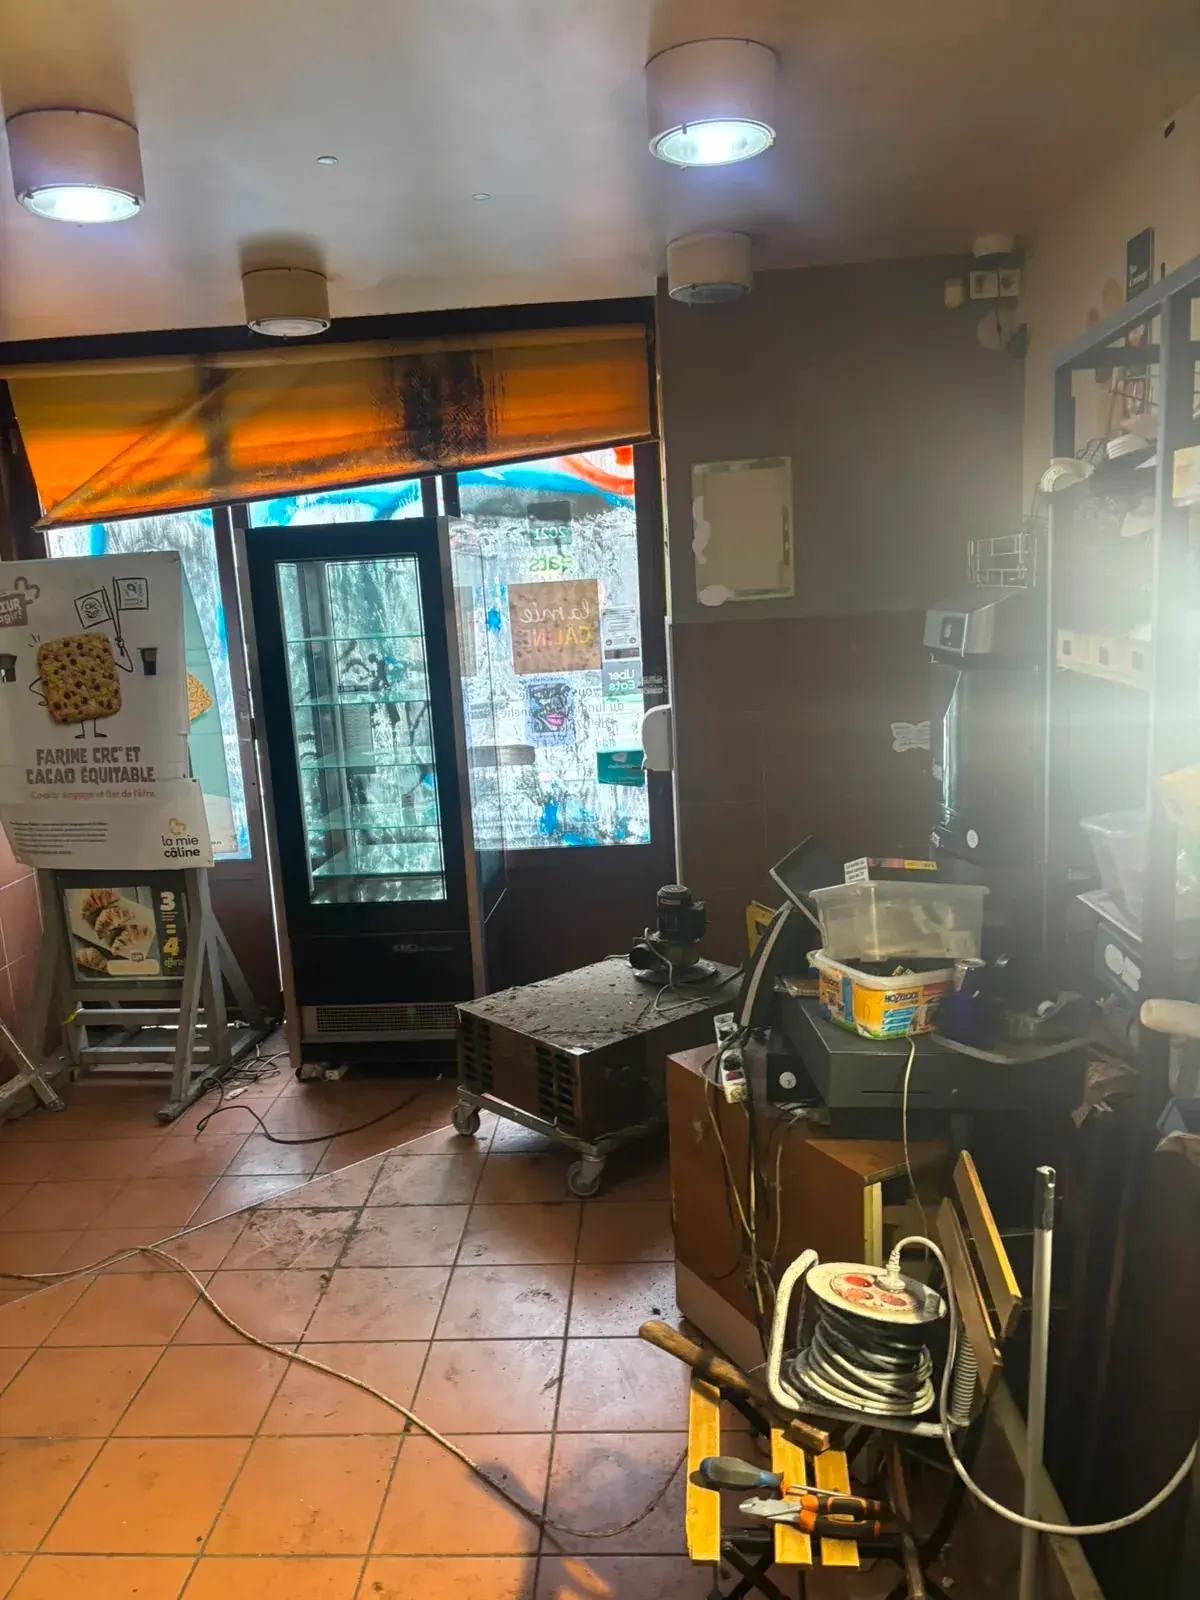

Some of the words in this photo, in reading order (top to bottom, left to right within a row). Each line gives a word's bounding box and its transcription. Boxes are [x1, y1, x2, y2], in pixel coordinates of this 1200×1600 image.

[36, 748, 88, 766] FARINE
[125, 746, 141, 763] ET
[26, 768, 75, 784] CACAO
[80, 766, 156, 785] ÉQUITABLE
[162, 834, 174, 846] la
[176, 834, 199, 846] mie
[164, 847, 200, 859] câline
[160, 891, 176, 911] 3
